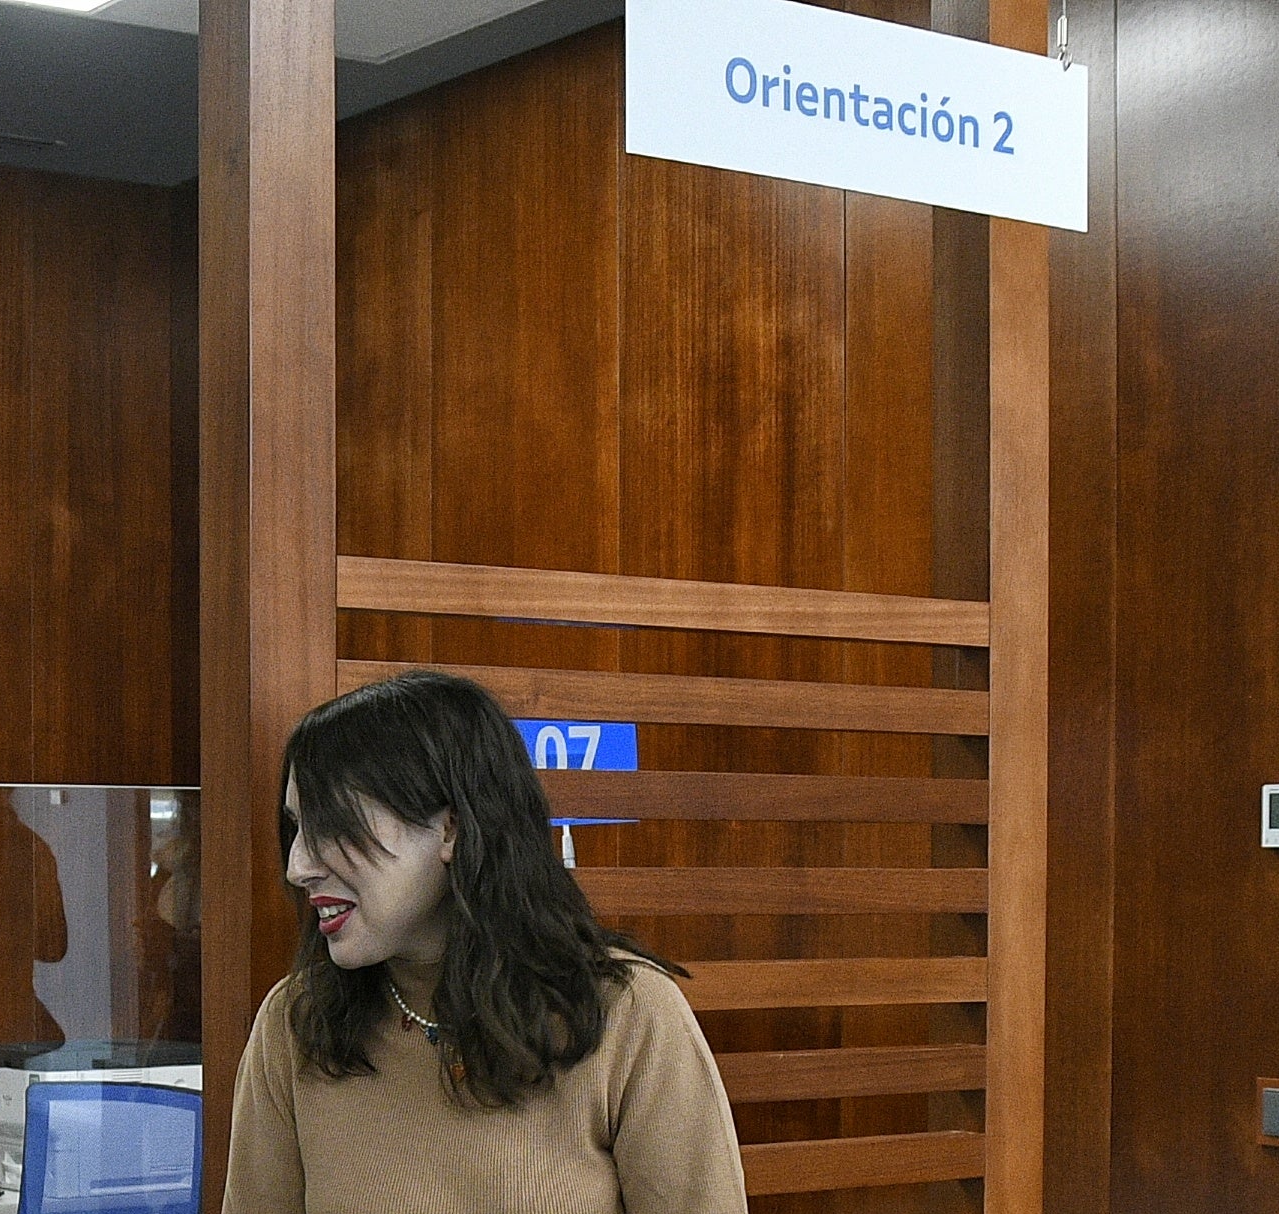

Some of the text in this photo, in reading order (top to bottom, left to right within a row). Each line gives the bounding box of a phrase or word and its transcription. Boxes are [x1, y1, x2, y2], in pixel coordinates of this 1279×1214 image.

[725, 57, 1015, 155] Orientación 2
[535, 725, 601, 770] 07
